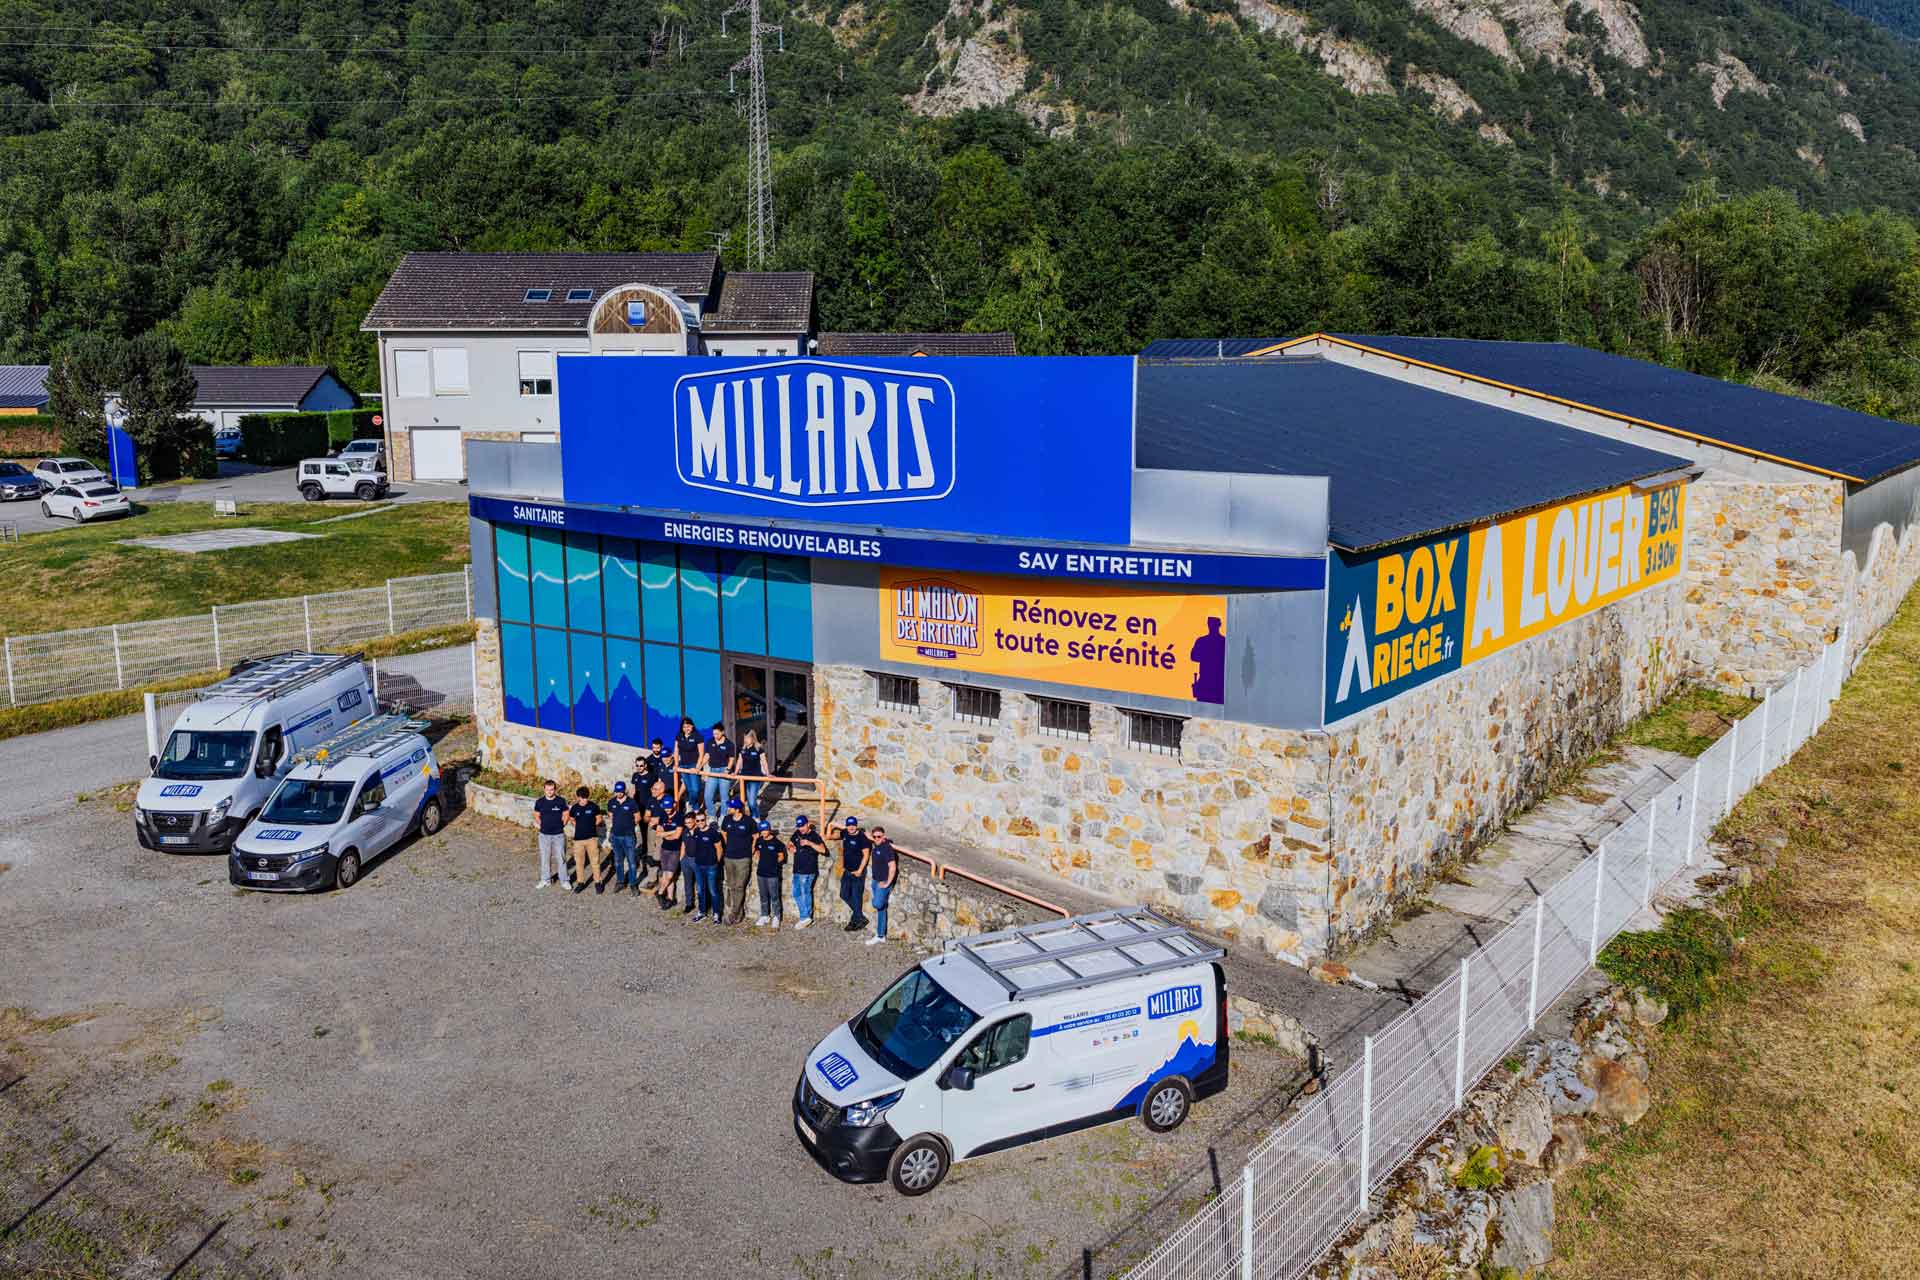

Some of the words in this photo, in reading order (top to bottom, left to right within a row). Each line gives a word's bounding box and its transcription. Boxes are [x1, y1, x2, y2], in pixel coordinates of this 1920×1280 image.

[687, 371, 936, 496] MILLARIS
[513, 506, 565, 525] SANITAIRE
[664, 522, 735, 544] ENERGIES
[738, 530, 881, 558] RENOUVELABLES
[1018, 551, 1060, 571] SAV
[1066, 554, 1193, 578] ENTRETIEN
[1520, 493, 1645, 629] LOUER
[897, 586, 915, 617] LA
[918, 583, 979, 626] MAISON
[1375, 539, 1460, 636] BOX
[896, 619, 918, 642] DES
[920, 621, 979, 650] ARTISANS
[1012, 599, 1117, 633] Rénovez
[1126, 615, 1158, 637] en
[994, 628, 1060, 657] toute
[1067, 635, 1177, 671] sérénité
[162, 785, 200, 797] MILLARIS
[258, 829, 300, 840] MILLARIS
[1150, 987, 1199, 1016] MILLARIS
[819, 1054, 857, 1088] MILLARIS
